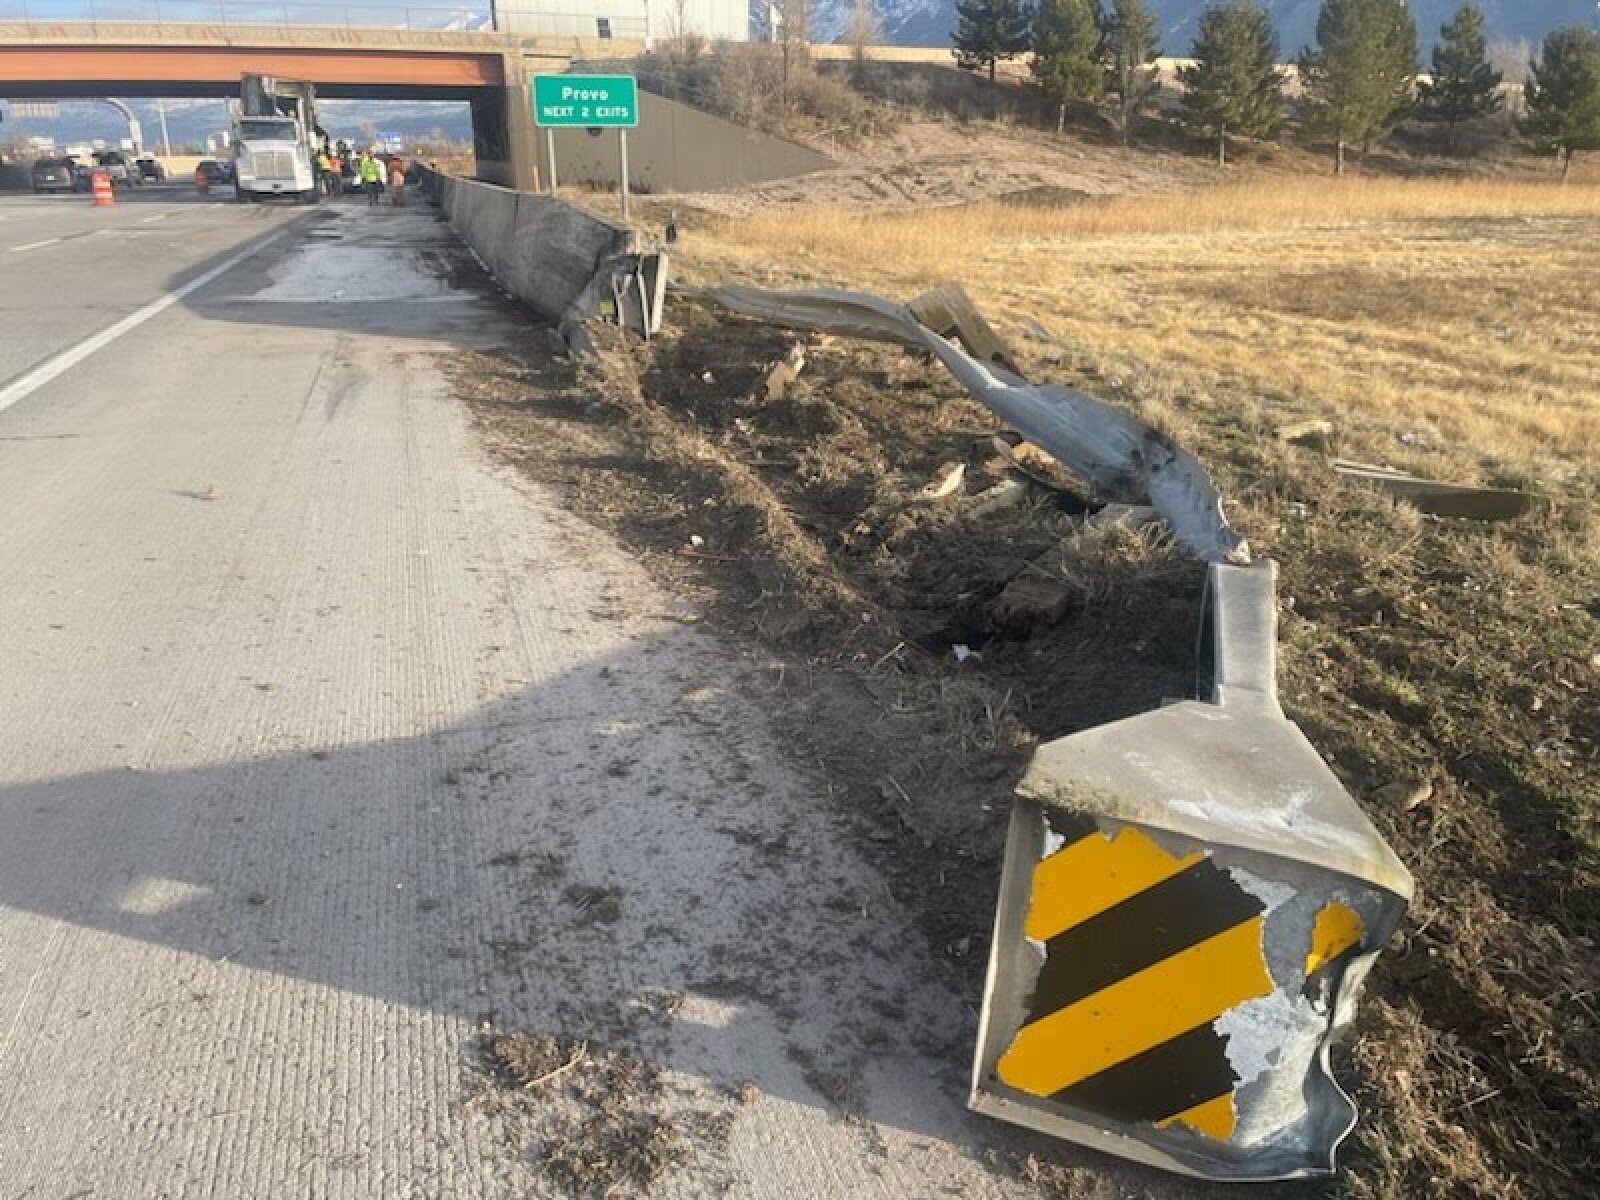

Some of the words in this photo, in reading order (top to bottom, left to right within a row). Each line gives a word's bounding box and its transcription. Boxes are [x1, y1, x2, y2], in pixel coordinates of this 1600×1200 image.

[562, 86, 608, 100] Provo
[544, 106, 574, 117] NEXT
[582, 106, 590, 118] 2
[596, 106, 628, 117] EXITS
